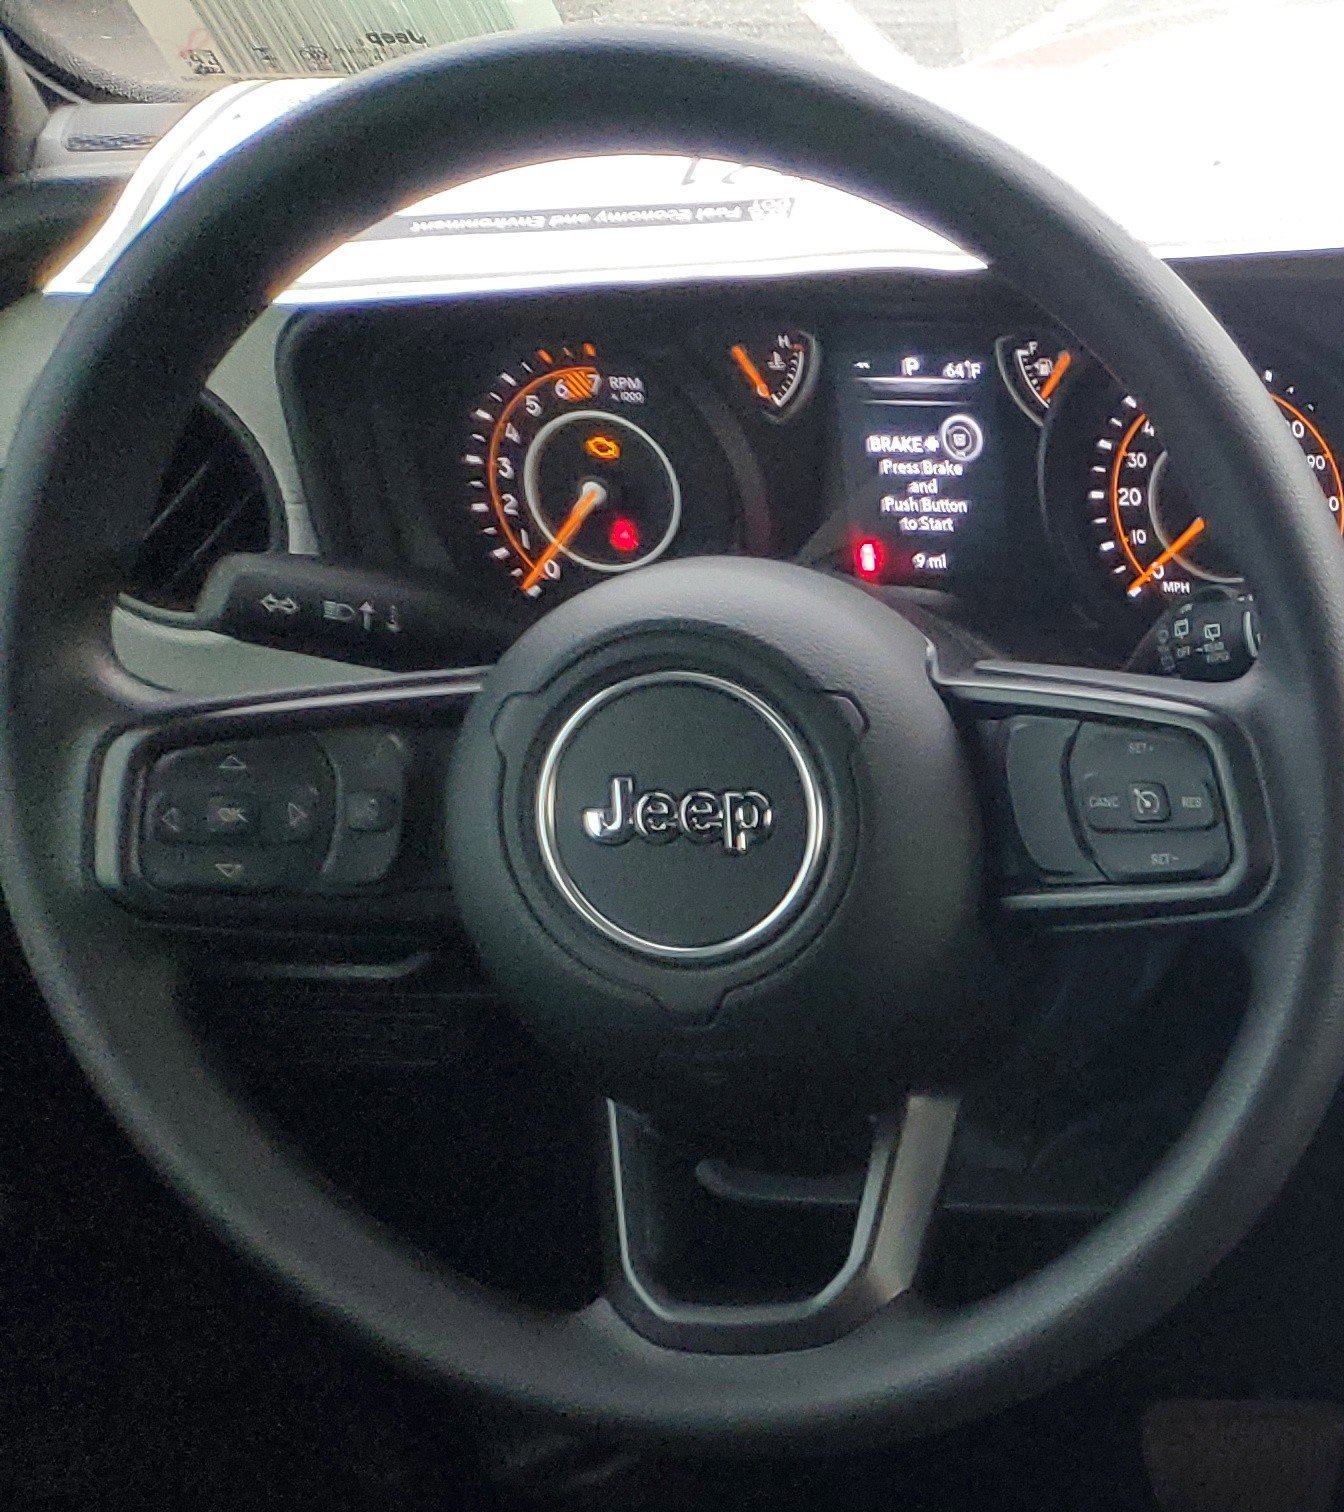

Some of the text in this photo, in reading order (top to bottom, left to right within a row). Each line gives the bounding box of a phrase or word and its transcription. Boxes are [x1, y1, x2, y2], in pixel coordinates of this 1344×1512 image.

[549, 211, 592, 228] and
[594, 207, 692, 226] Economy
[698, 205, 743, 221] Fuel
[409, 215, 545, 233] Environment
[902, 355, 920, 376] P
[555, 379, 569, 399] 6
[587, 373, 602, 396] 7
[609, 376, 645, 391] RPM
[525, 395, 542, 417] 5
[504, 422, 521, 444] 4
[866, 434, 924, 453] BRAKE
[498, 457, 514, 480] 3
[879, 459, 964, 476] Press Brake
[1126, 453, 1147, 469] 30
[1307, 454, 1326, 471] 90
[906, 478, 939, 494] and
[501, 493, 519, 516] 2
[880, 495, 969, 513] Push Button
[1118, 487, 1142, 506] 20
[899, 516, 955, 532] to Start
[1132, 529, 1147, 544] 10
[911, 552, 926, 569] 9
[1163, 581, 1191, 594] MPH
[583, 774, 773, 855] Jeep
[1151, 853, 1170, 865] SET
